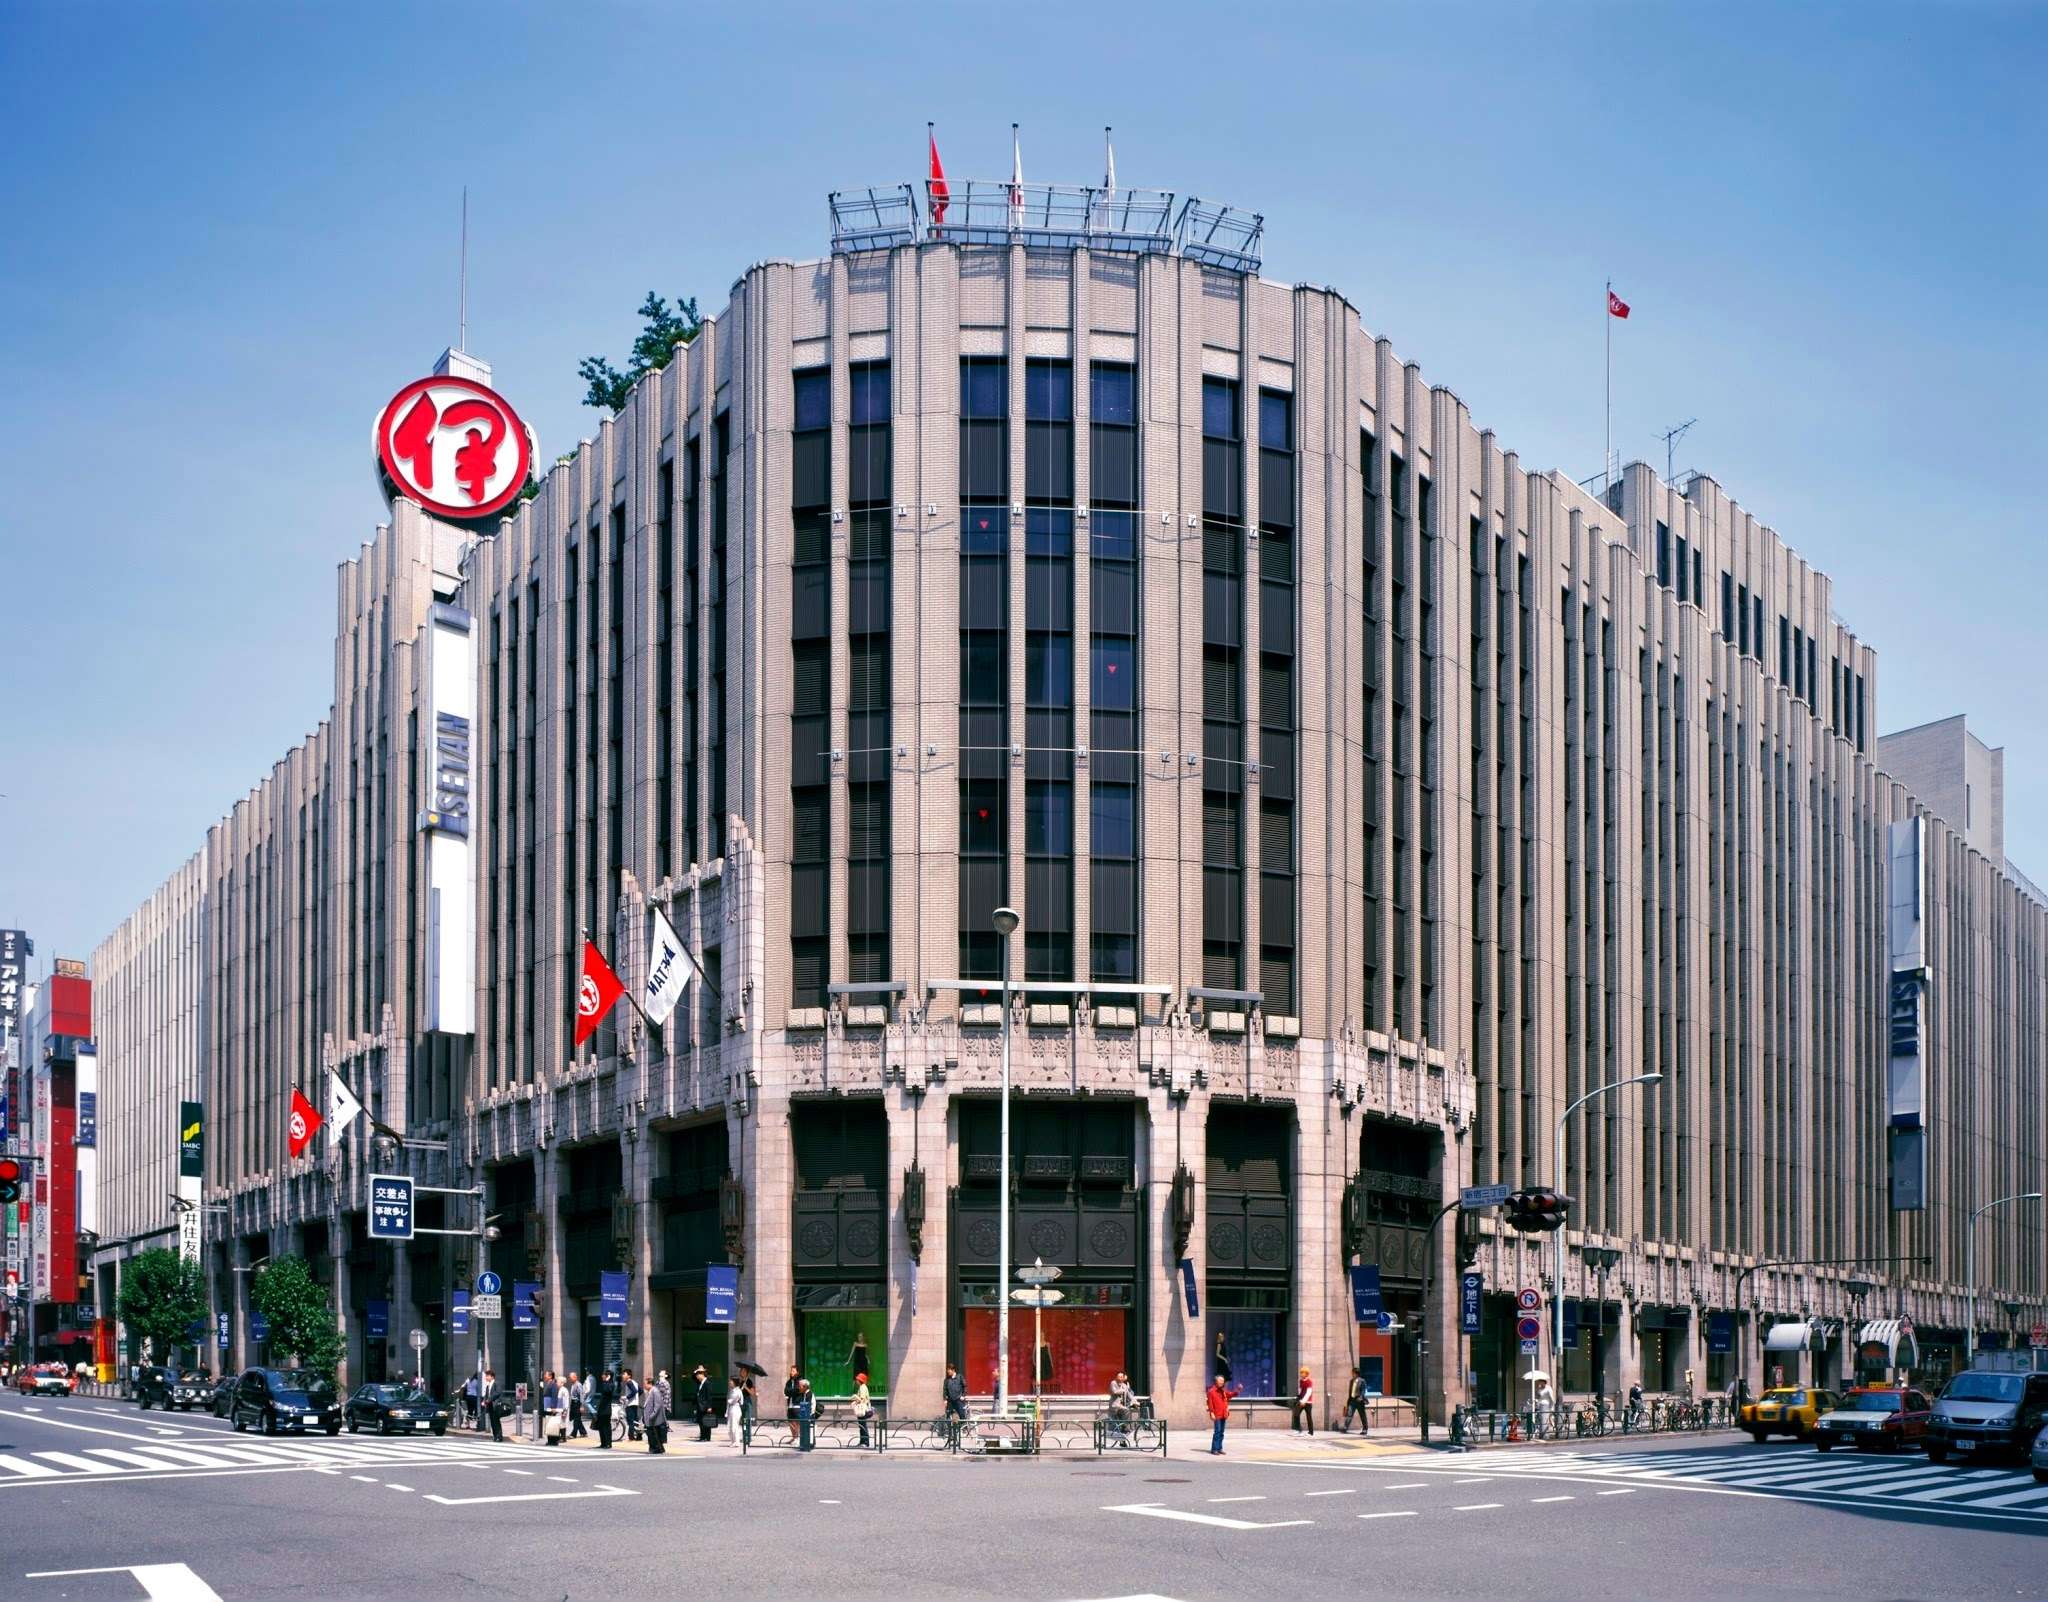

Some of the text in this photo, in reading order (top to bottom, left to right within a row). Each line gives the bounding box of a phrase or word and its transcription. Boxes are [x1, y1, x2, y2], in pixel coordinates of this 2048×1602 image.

[182, 1142, 201, 1150] SMBC
[375, 1187, 407, 1200] 交差点
[375, 1206, 408, 1216] 事故多し
[1466, 1289, 1478, 1325] 地下鉄
